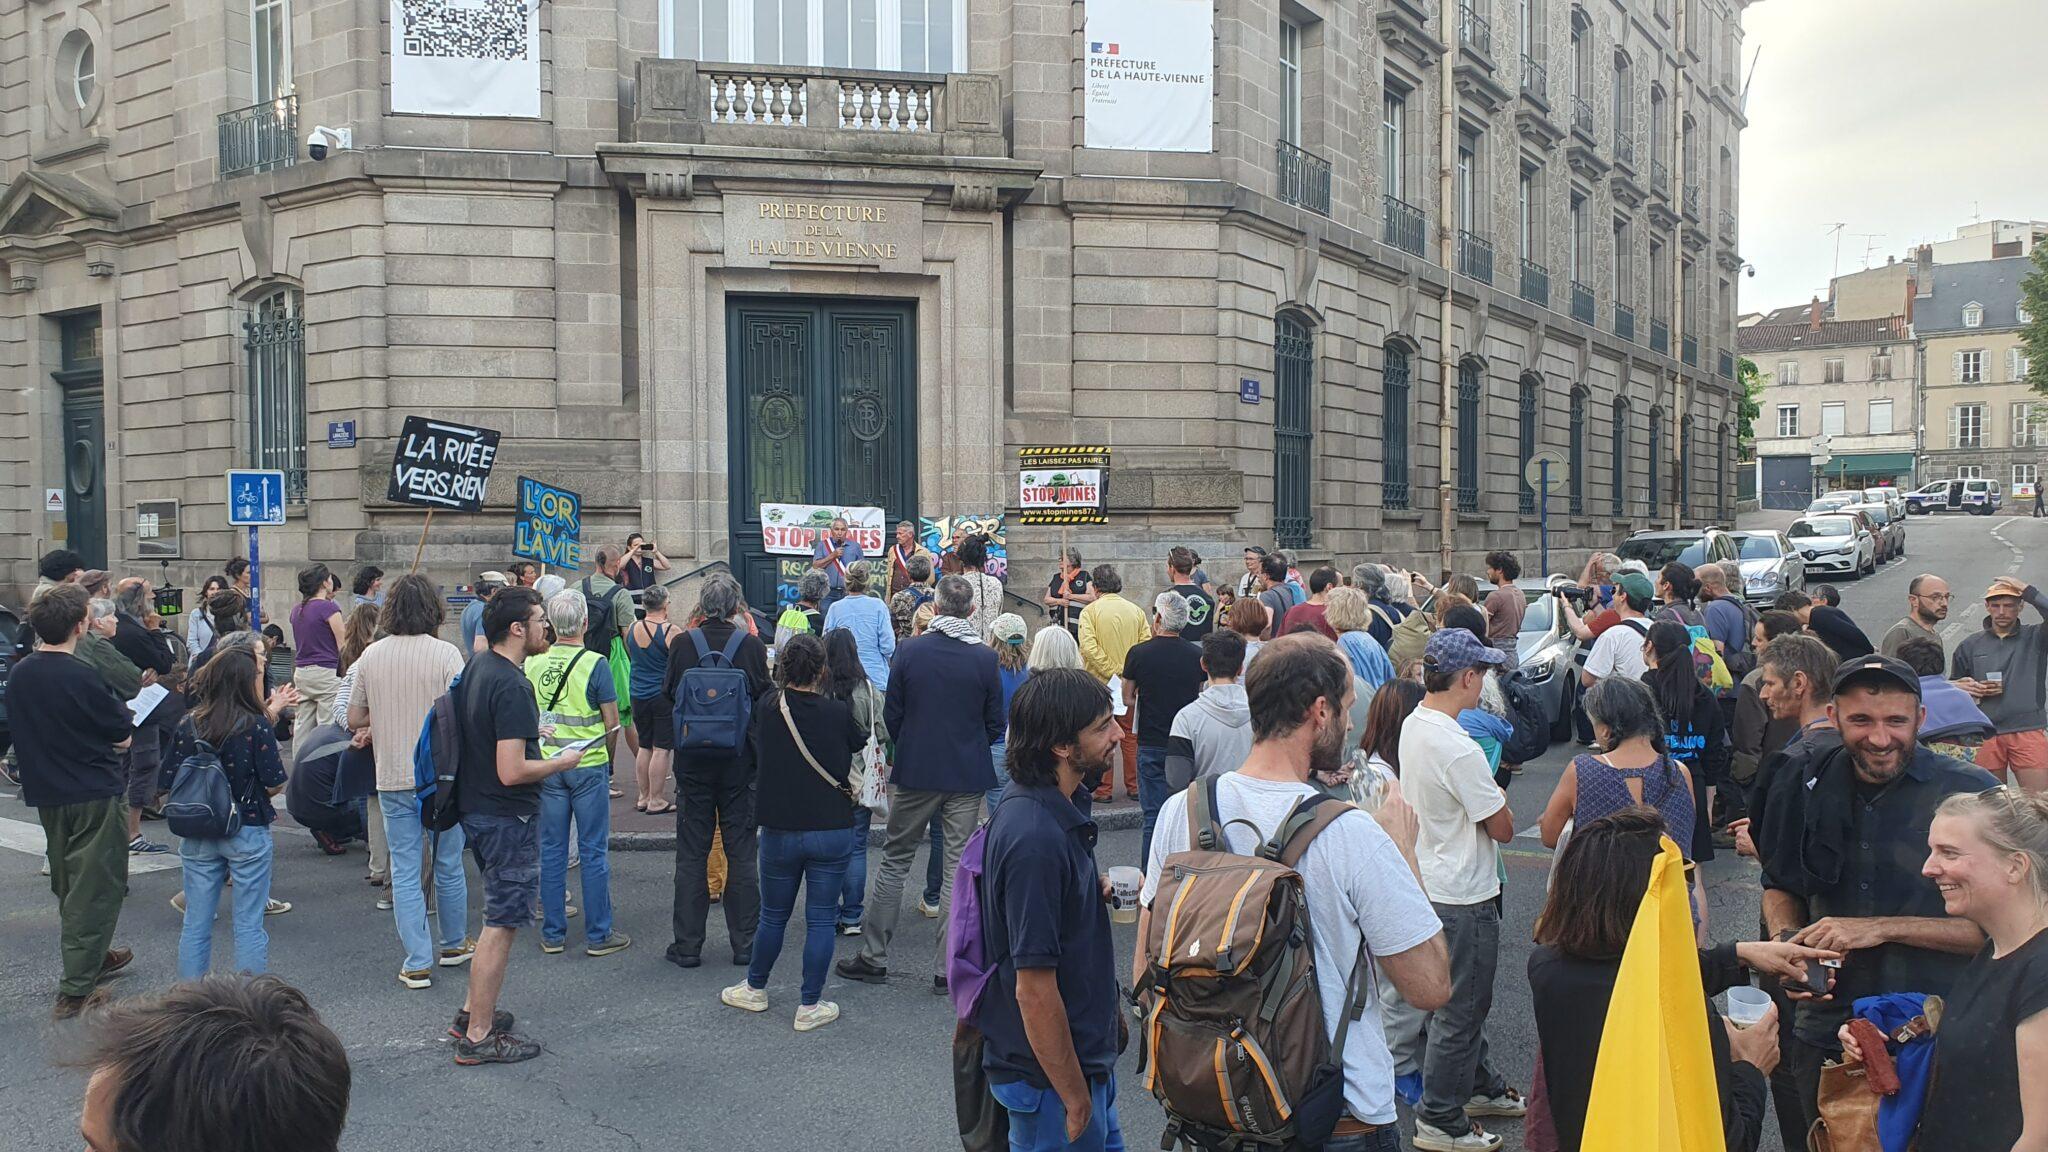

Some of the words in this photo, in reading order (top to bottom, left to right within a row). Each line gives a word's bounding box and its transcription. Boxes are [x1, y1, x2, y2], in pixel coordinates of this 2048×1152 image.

[1090, 57, 1156, 70] PRÉFECTURE
[1090, 69, 1104, 79] DE
[1107, 71, 1121, 80] LA
[1124, 72, 1205, 84] HAUTE-VIENNE
[759, 202, 887, 222] PREFECTURE
[805, 225, 822, 236] DE
[826, 226, 842, 237] LA
[750, 239, 817, 256] HAUTE
[820, 241, 897, 259] VIENNE
[404, 433, 436, 462] LA
[443, 436, 496, 469] RUÉE
[396, 464, 450, 496] VERS
[1023, 487, 1055, 502] STOP
[1058, 486, 1096, 502] MINES
[524, 480, 579, 534] L'OR
[532, 516, 554, 535] OU
[515, 522, 547, 559] LA
[764, 526, 815, 548] STOP
